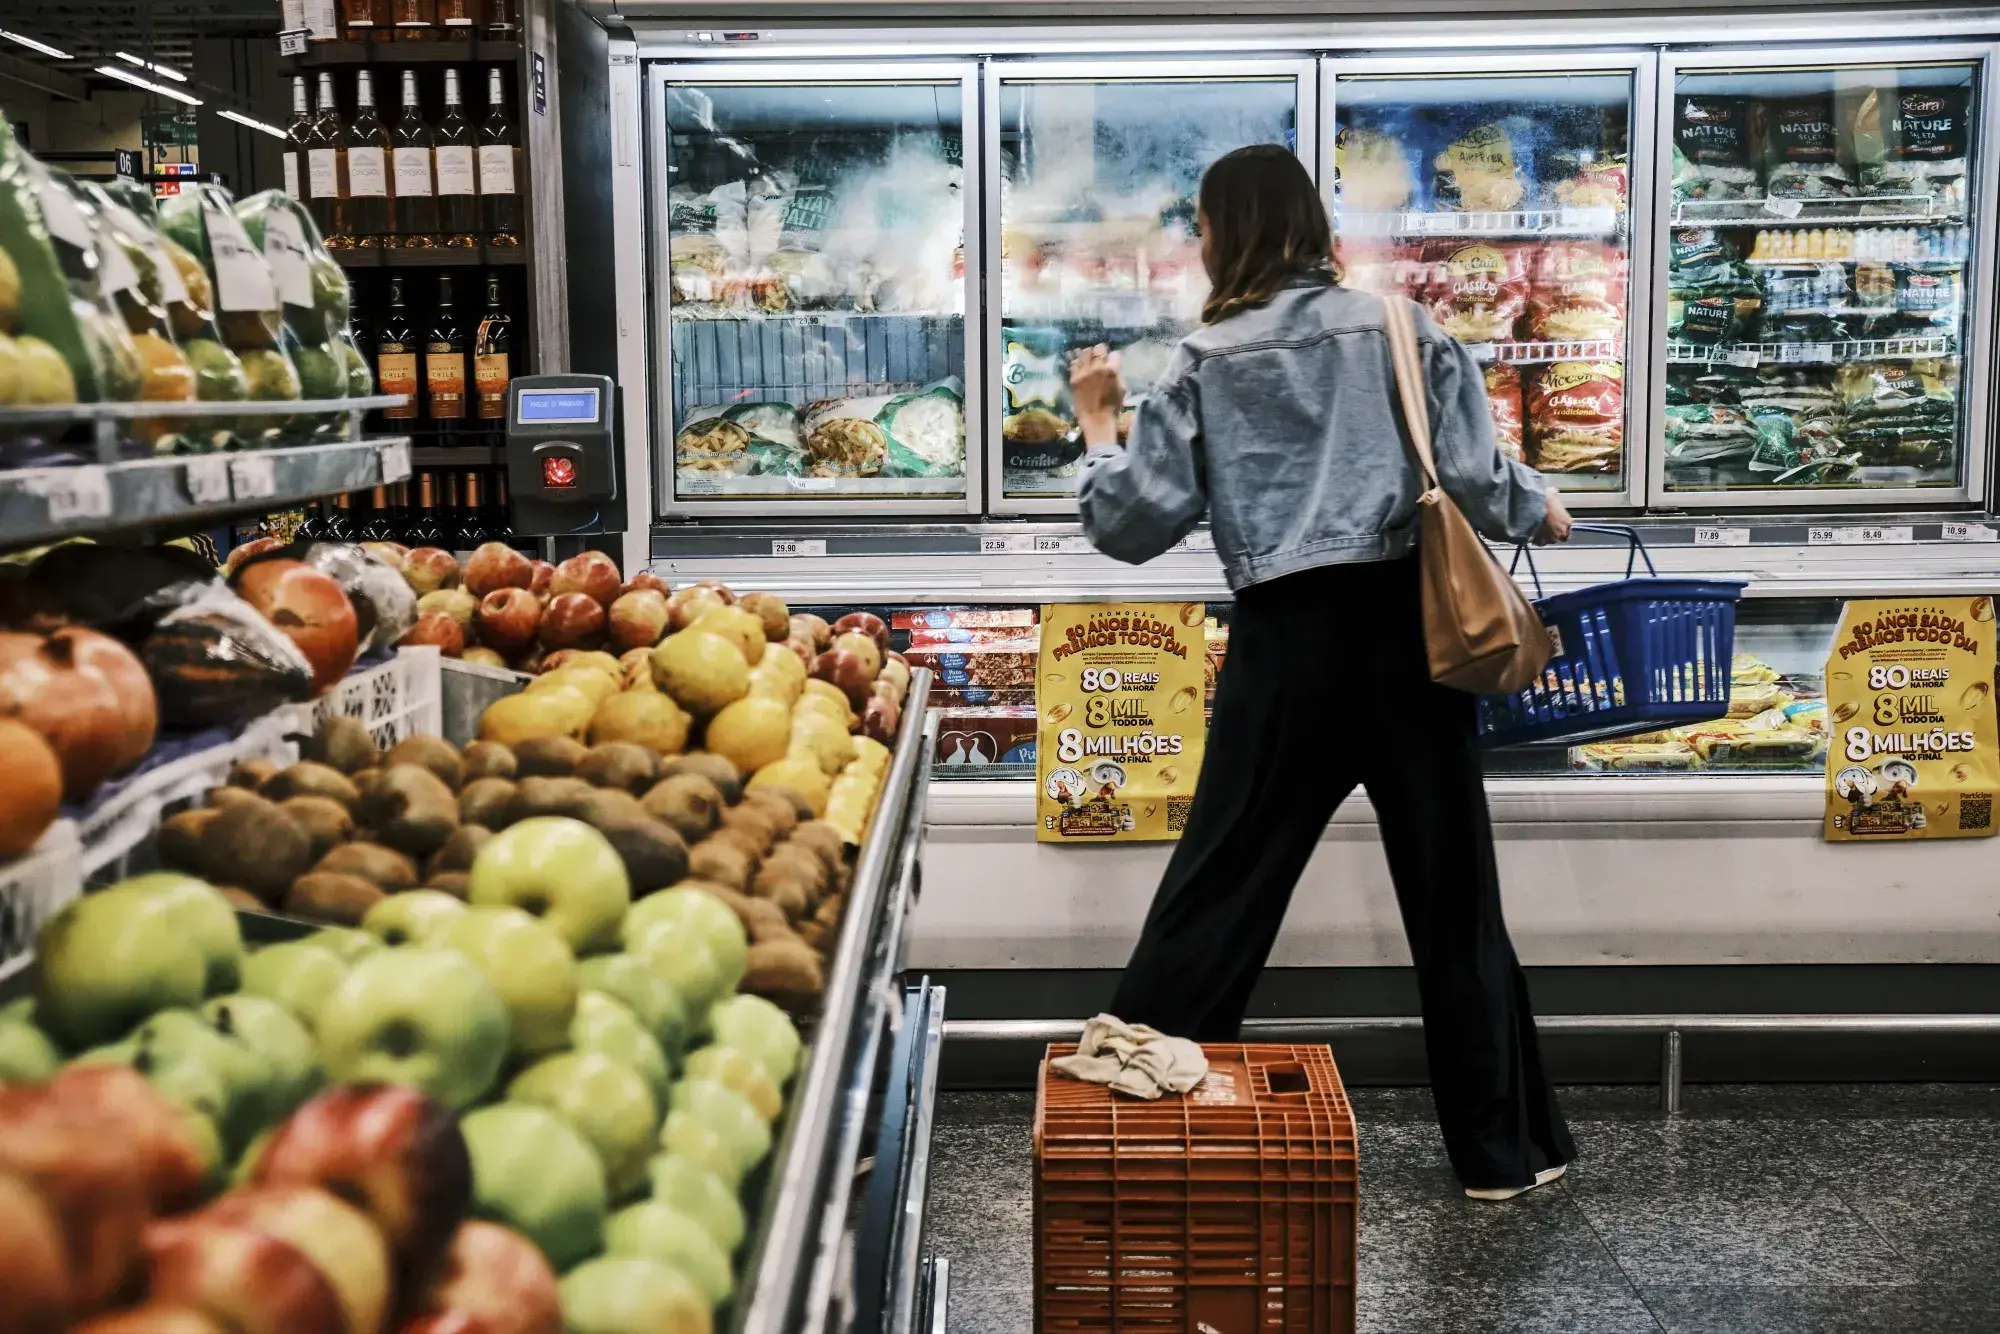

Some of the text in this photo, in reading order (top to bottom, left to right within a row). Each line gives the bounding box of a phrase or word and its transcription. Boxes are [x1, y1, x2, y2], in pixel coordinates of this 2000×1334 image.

[1902, 99, 1939, 110] Seara
[1682, 125, 1737, 139] NATURE
[1780, 122, 1839, 135] NATURE
[1892, 119, 1952, 131] NATURE
[120, 152, 131, 174] 06
[1903, 288, 1950, 297] NATURE
[1688, 307, 1728, 319] NATURE
[1886, 380, 1915, 388] TURE
[1010, 453, 1059, 467] Crinkle
[1090, 611, 1155, 619] PROMOÇÃO
[1878, 607, 1944, 616] PROMOÇÃO
[1065, 617, 1175, 641] 80 ANOS SADIA
[1852, 614, 1965, 639] 80 ANOS SADIA
[1119, 632, 1162, 648] TODO
[1163, 637, 1188, 660] DIA
[1907, 628, 1951, 644] TODO
[1953, 635, 1978, 655] DIA
[1080, 667, 1160, 693] 80 REAIS
[1868, 664, 1950, 691] 80 REAIS
[1086, 695, 1149, 728] 8 MIL
[1873, 693, 1939, 726] 8 MIL
[1112, 719, 1138, 727] TODO
[1901, 716, 1928, 724] TODO
[1057, 728, 1183, 763] 8 MILHÕES
[1845, 726, 1975, 762] 8 MILHÕES
[1167, 794, 1193, 802] Particip
